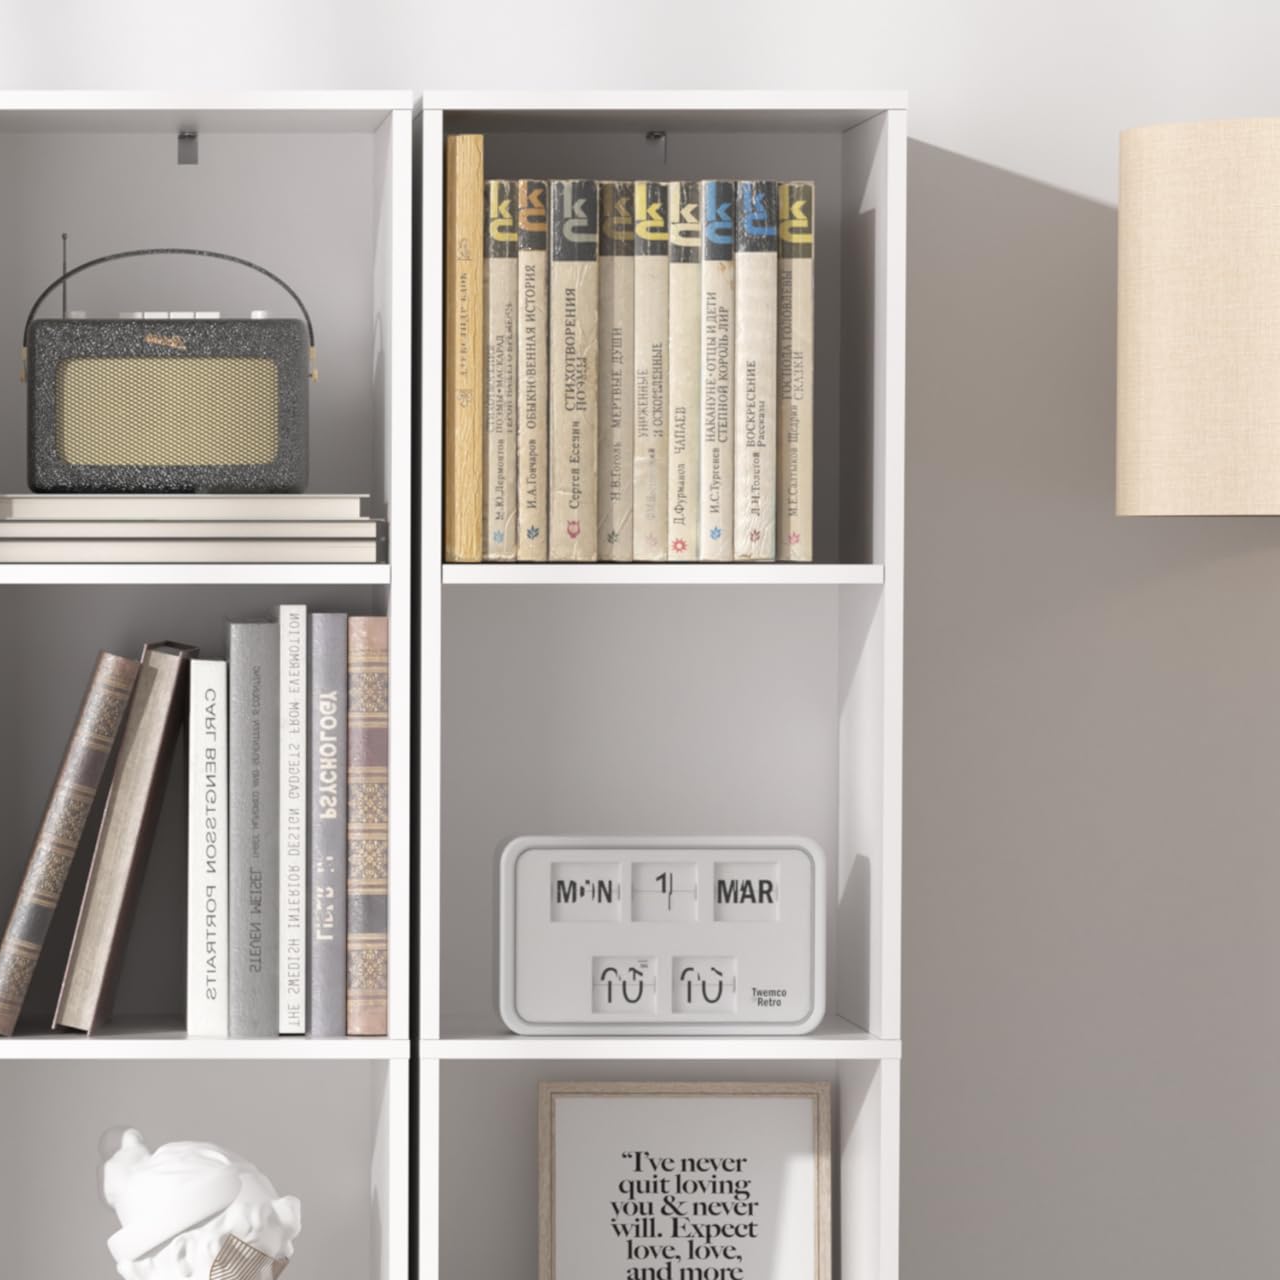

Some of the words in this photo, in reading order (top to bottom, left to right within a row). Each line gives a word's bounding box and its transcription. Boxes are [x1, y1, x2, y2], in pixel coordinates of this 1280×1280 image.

[717, 880, 774, 904] MAR
[752, 988, 788, 998] Twemco
[757, 997, 782, 1007] Retro
[681, 1151, 747, 1173] never
[619, 1174, 671, 1200] quit
[675, 1174, 751, 1200] loving
[611, 1200, 653, 1222] you
[660, 1195, 689, 1217] &
[693, 1200, 759, 1217] never
[611, 1218, 663, 1239] will.
[671, 1217, 758, 1244] Expect
[626, 1240, 681, 1264] love,
[687, 1240, 743, 1264] love,
